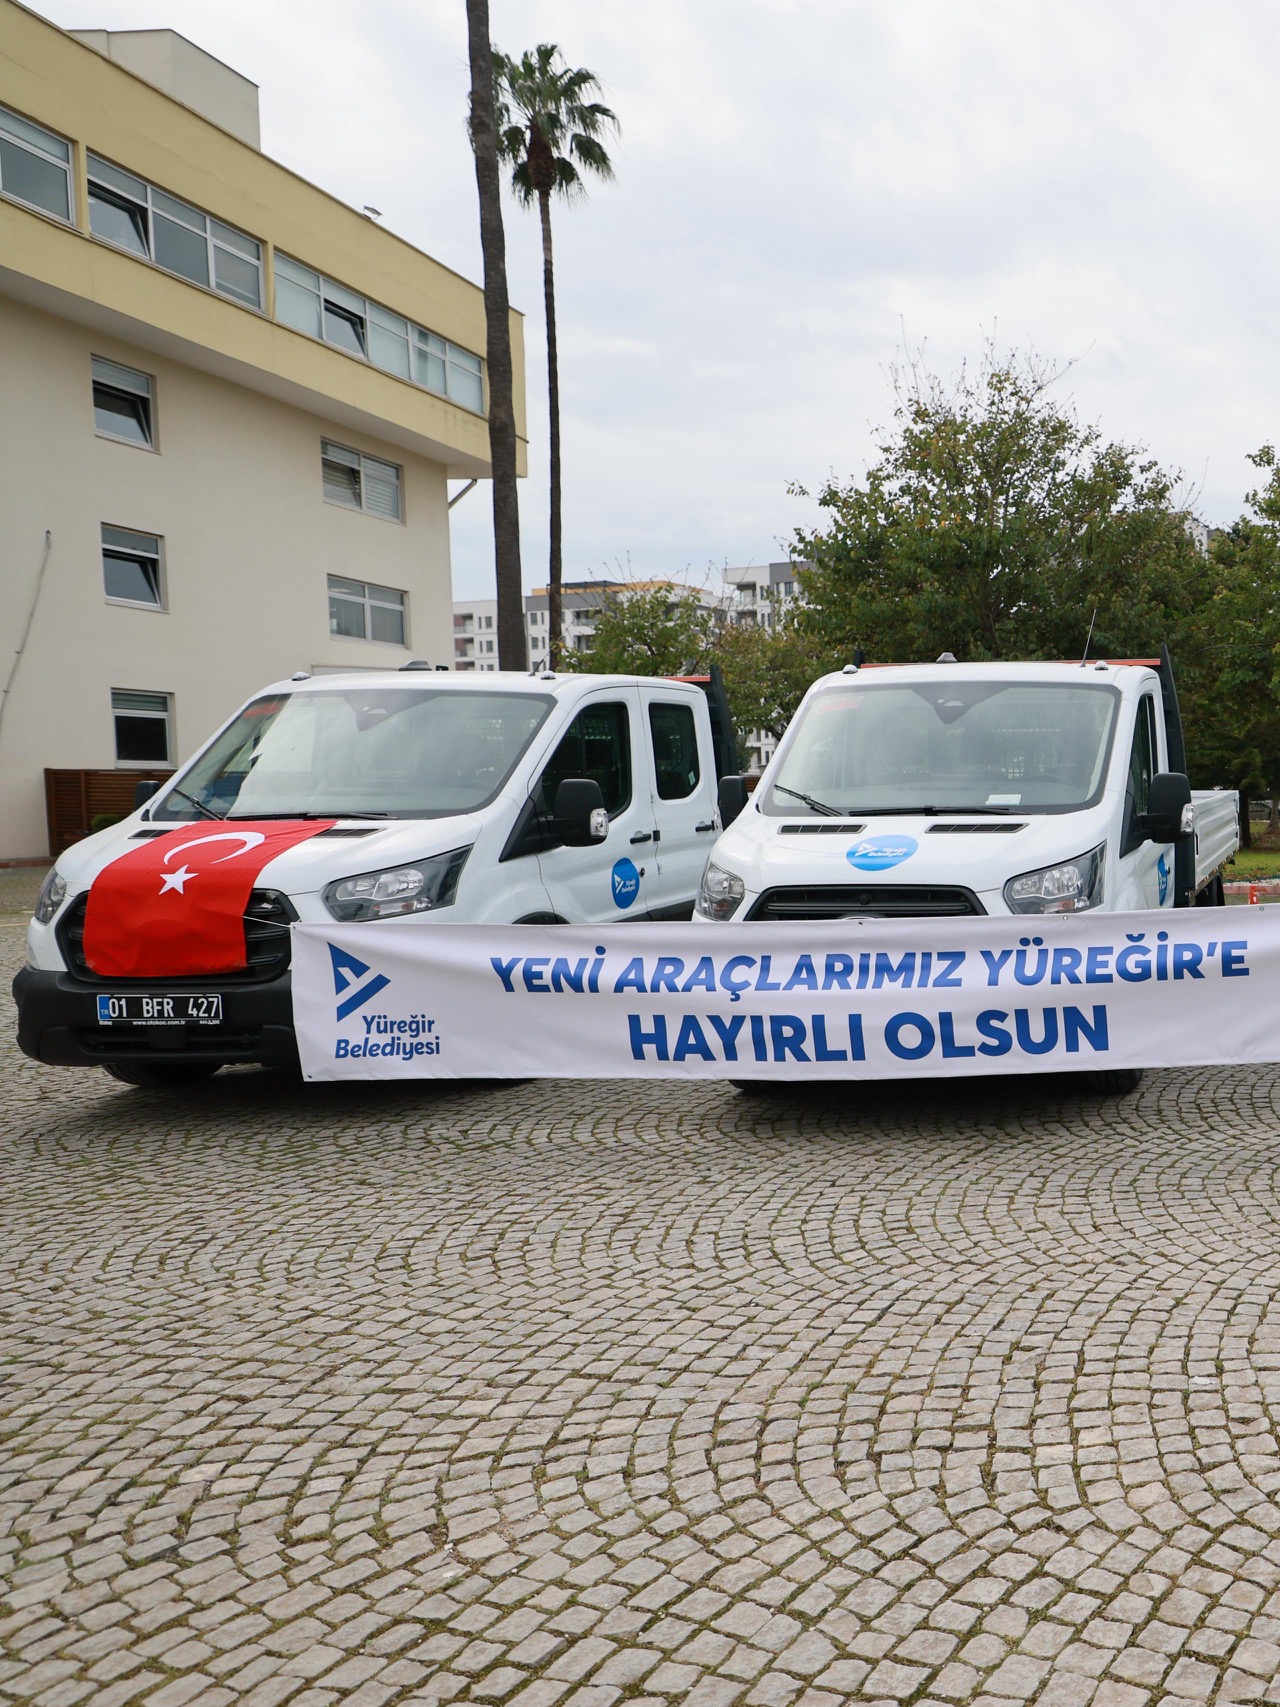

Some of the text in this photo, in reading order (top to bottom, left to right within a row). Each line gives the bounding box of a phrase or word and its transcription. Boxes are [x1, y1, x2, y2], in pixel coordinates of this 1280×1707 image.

[489, 930, 1250, 1002] YENİ ARAÇLARIMIZ YÜREĞİR'E
[109, 998, 127, 1018] 01
[142, 998, 174, 1018] BFR
[188, 997, 218, 1017] 427
[361, 1014, 435, 1038] Yüreğir
[627, 1003, 1110, 1062] HAYIRLI OLSUN
[335, 1036, 441, 1061] Belediyesi
